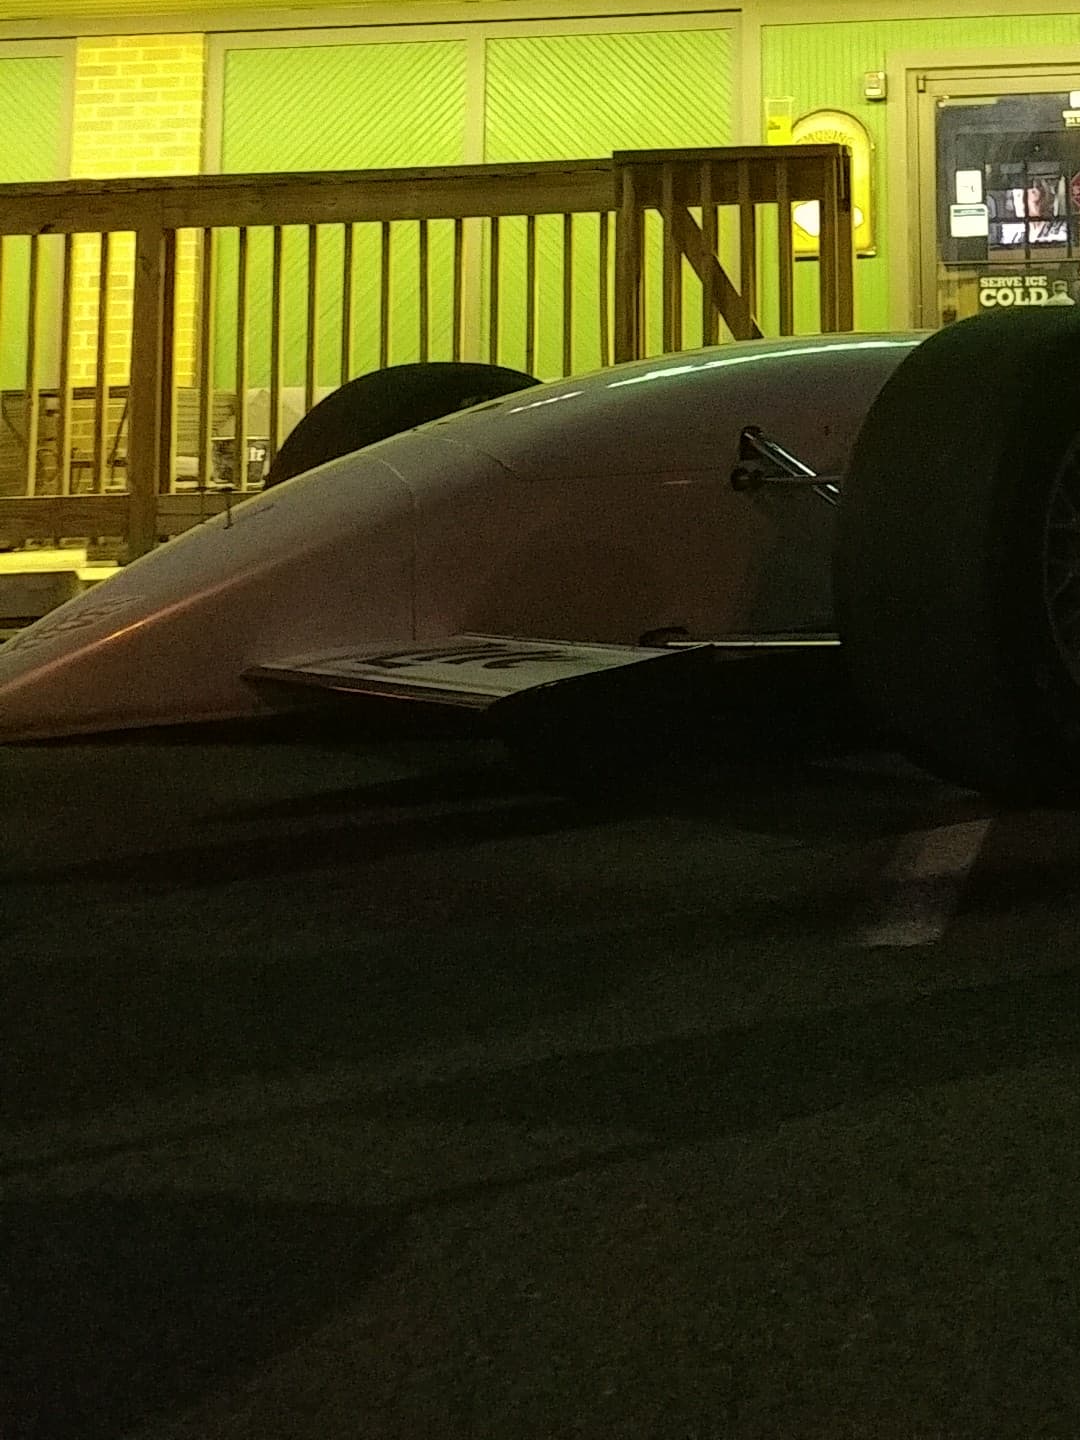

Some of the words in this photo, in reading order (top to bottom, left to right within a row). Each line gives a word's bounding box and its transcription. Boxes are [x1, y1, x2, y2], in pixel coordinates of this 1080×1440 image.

[980, 276, 1022, 288] SERVE
[1024, 275, 1048, 287] ICE
[980, 287, 1049, 307] COLD
